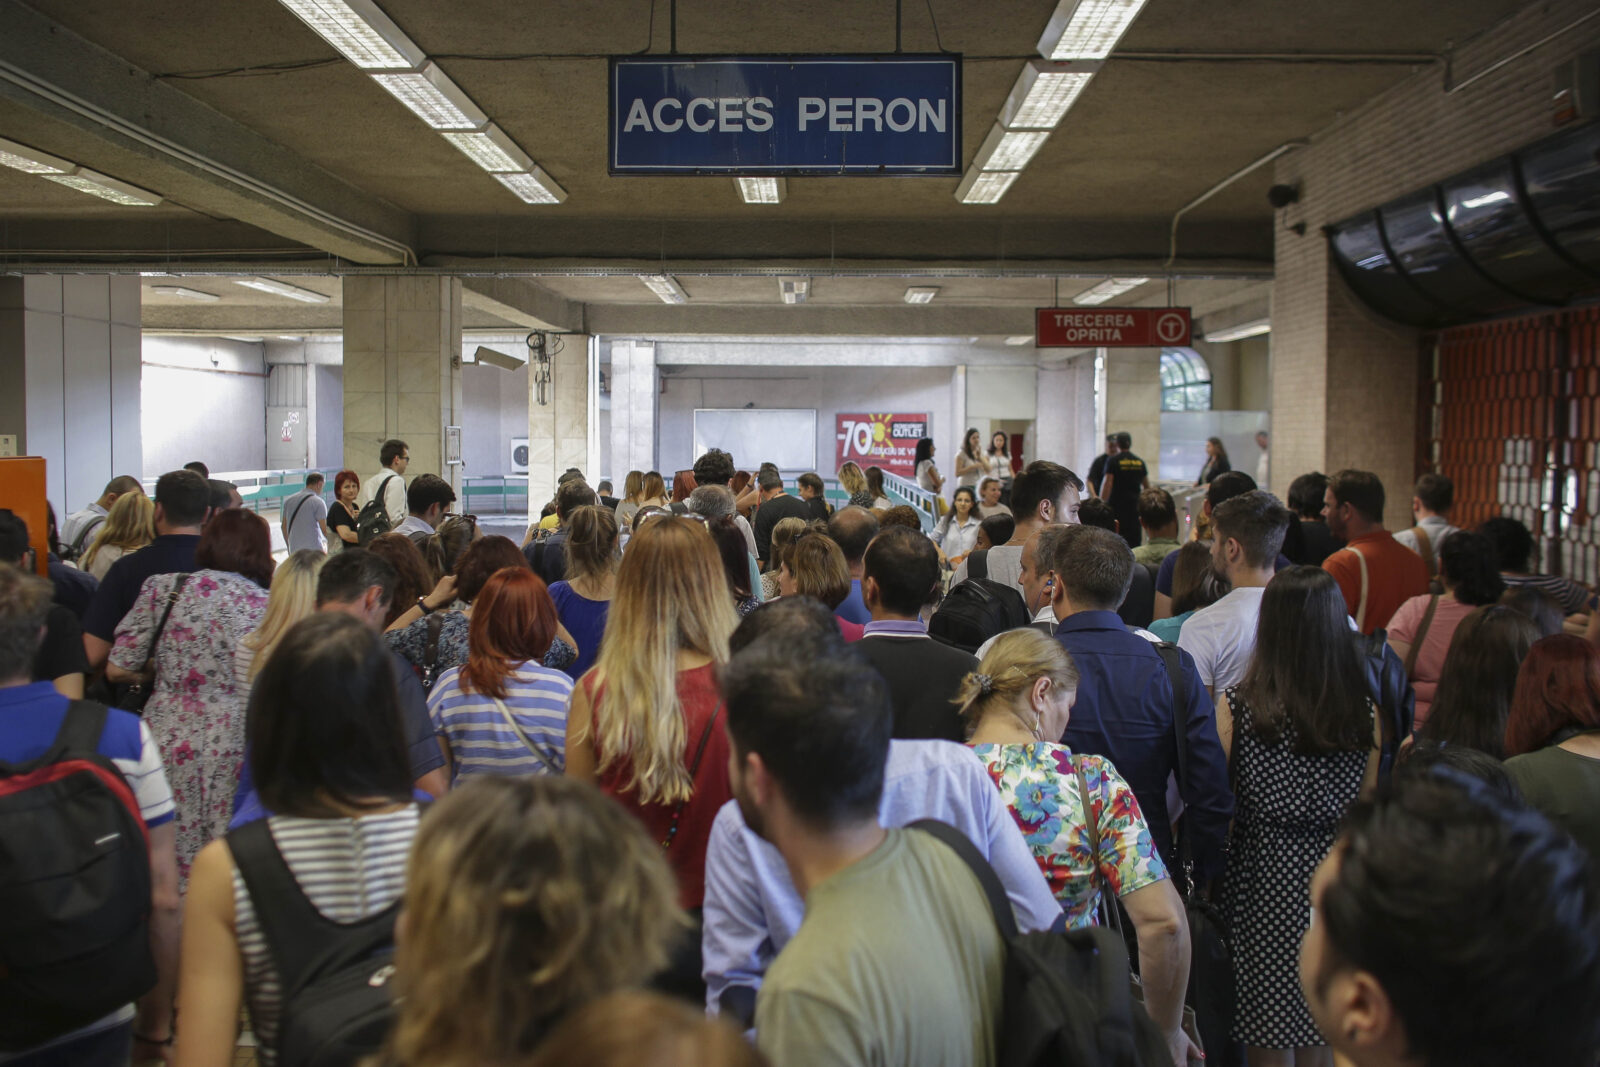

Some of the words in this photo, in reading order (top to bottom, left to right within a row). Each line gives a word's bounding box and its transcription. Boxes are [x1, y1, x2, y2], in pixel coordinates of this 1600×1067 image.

[623, 97, 774, 133] ACCES
[798, 97, 946, 133] PERON
[1054, 314, 1135, 327] TRECEREA
[1066, 328, 1122, 341] OPRITA
[892, 428, 923, 438] OUTLET
